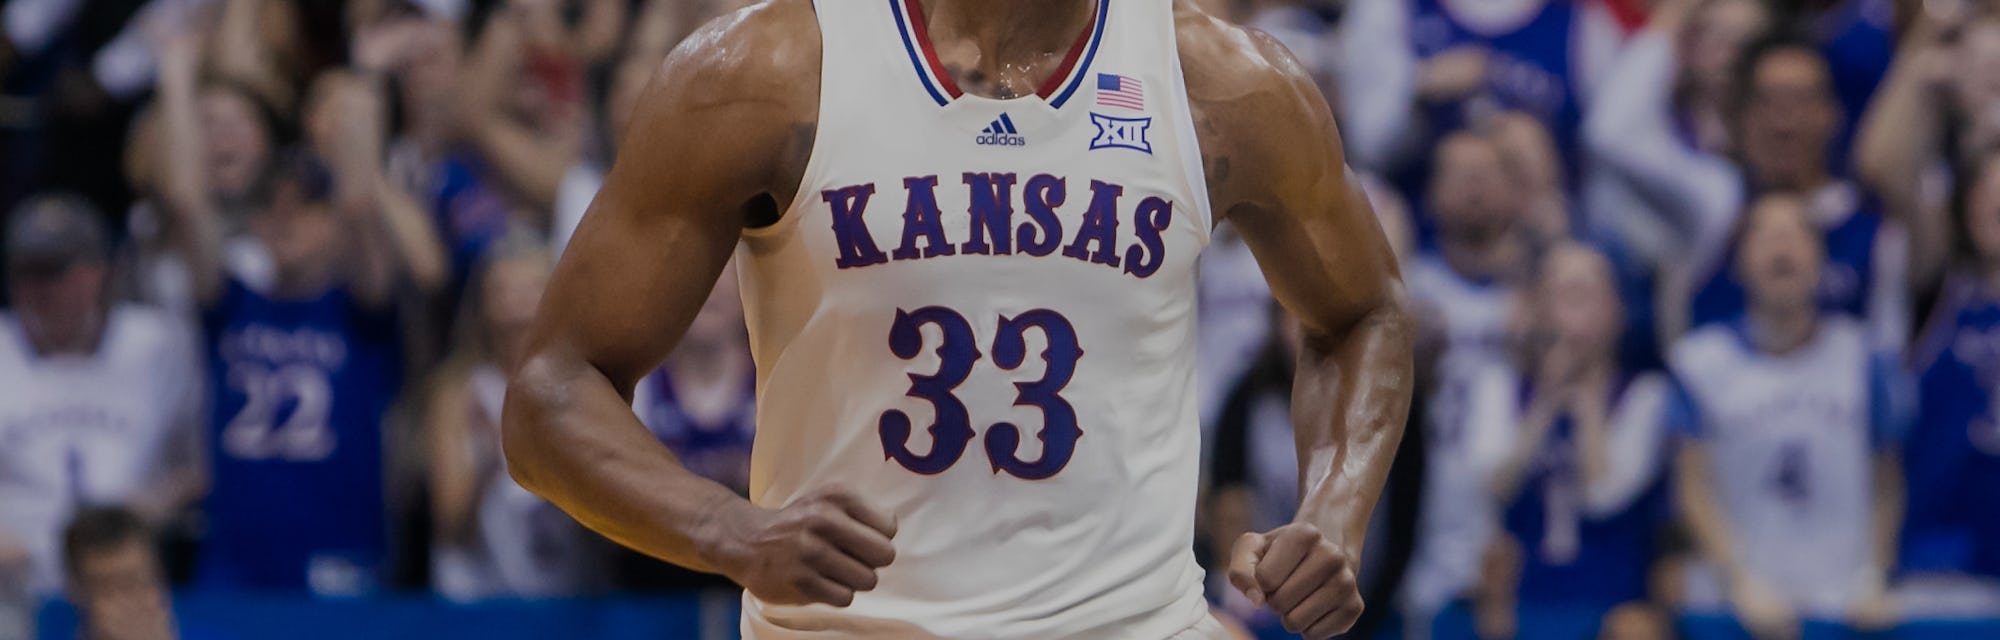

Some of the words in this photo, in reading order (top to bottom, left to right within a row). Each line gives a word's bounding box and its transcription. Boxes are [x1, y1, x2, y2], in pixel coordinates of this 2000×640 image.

[976, 133, 1025, 146] adidas
[821, 172, 1173, 278] KANSAS
[220, 362, 339, 462] 22
[879, 306, 1084, 480] 33
